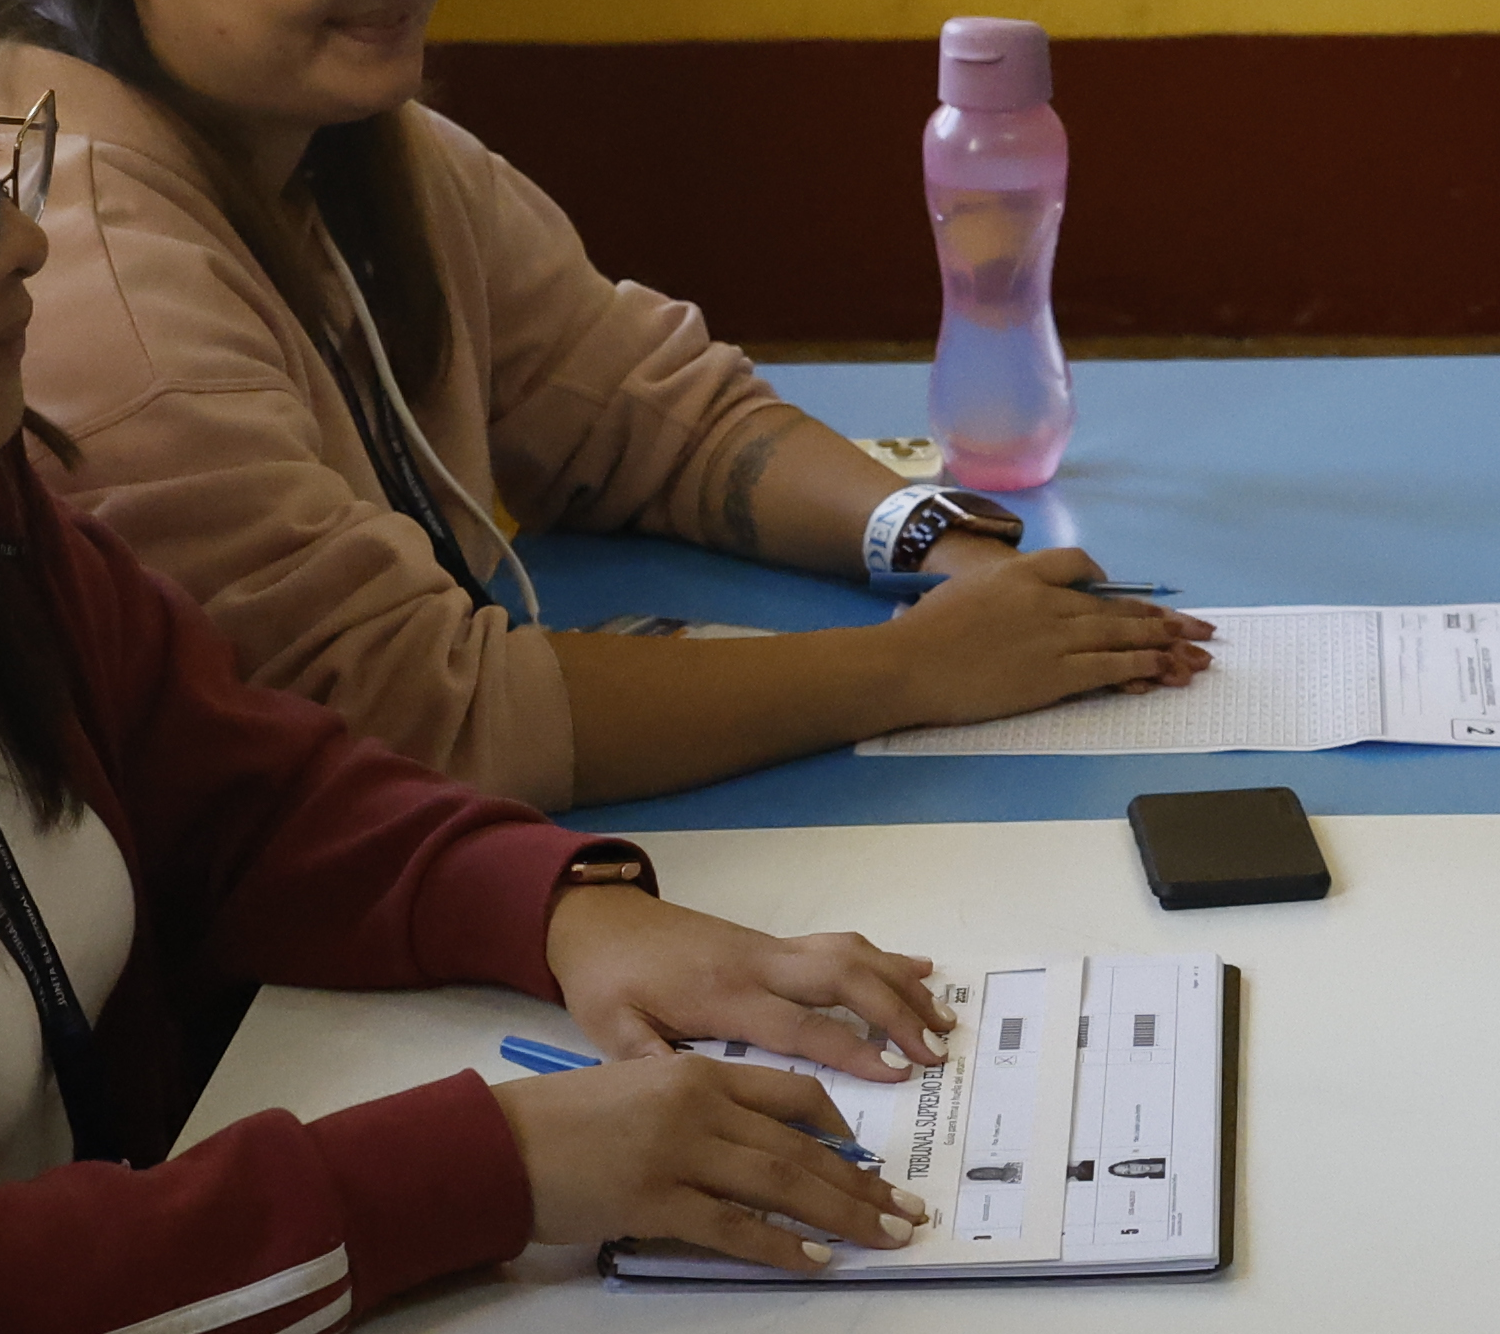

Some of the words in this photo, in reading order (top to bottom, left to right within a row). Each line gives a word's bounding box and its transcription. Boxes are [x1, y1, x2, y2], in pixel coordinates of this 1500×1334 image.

[20, 895, 54, 965] ELECTORAL
[49, 968, 69, 1006] JUNTA
[915, 1080, 942, 1127] SUPREMO
[907, 1128, 935, 1181] TRIBUNAL
[1120, 1228, 1140, 1236] 5
